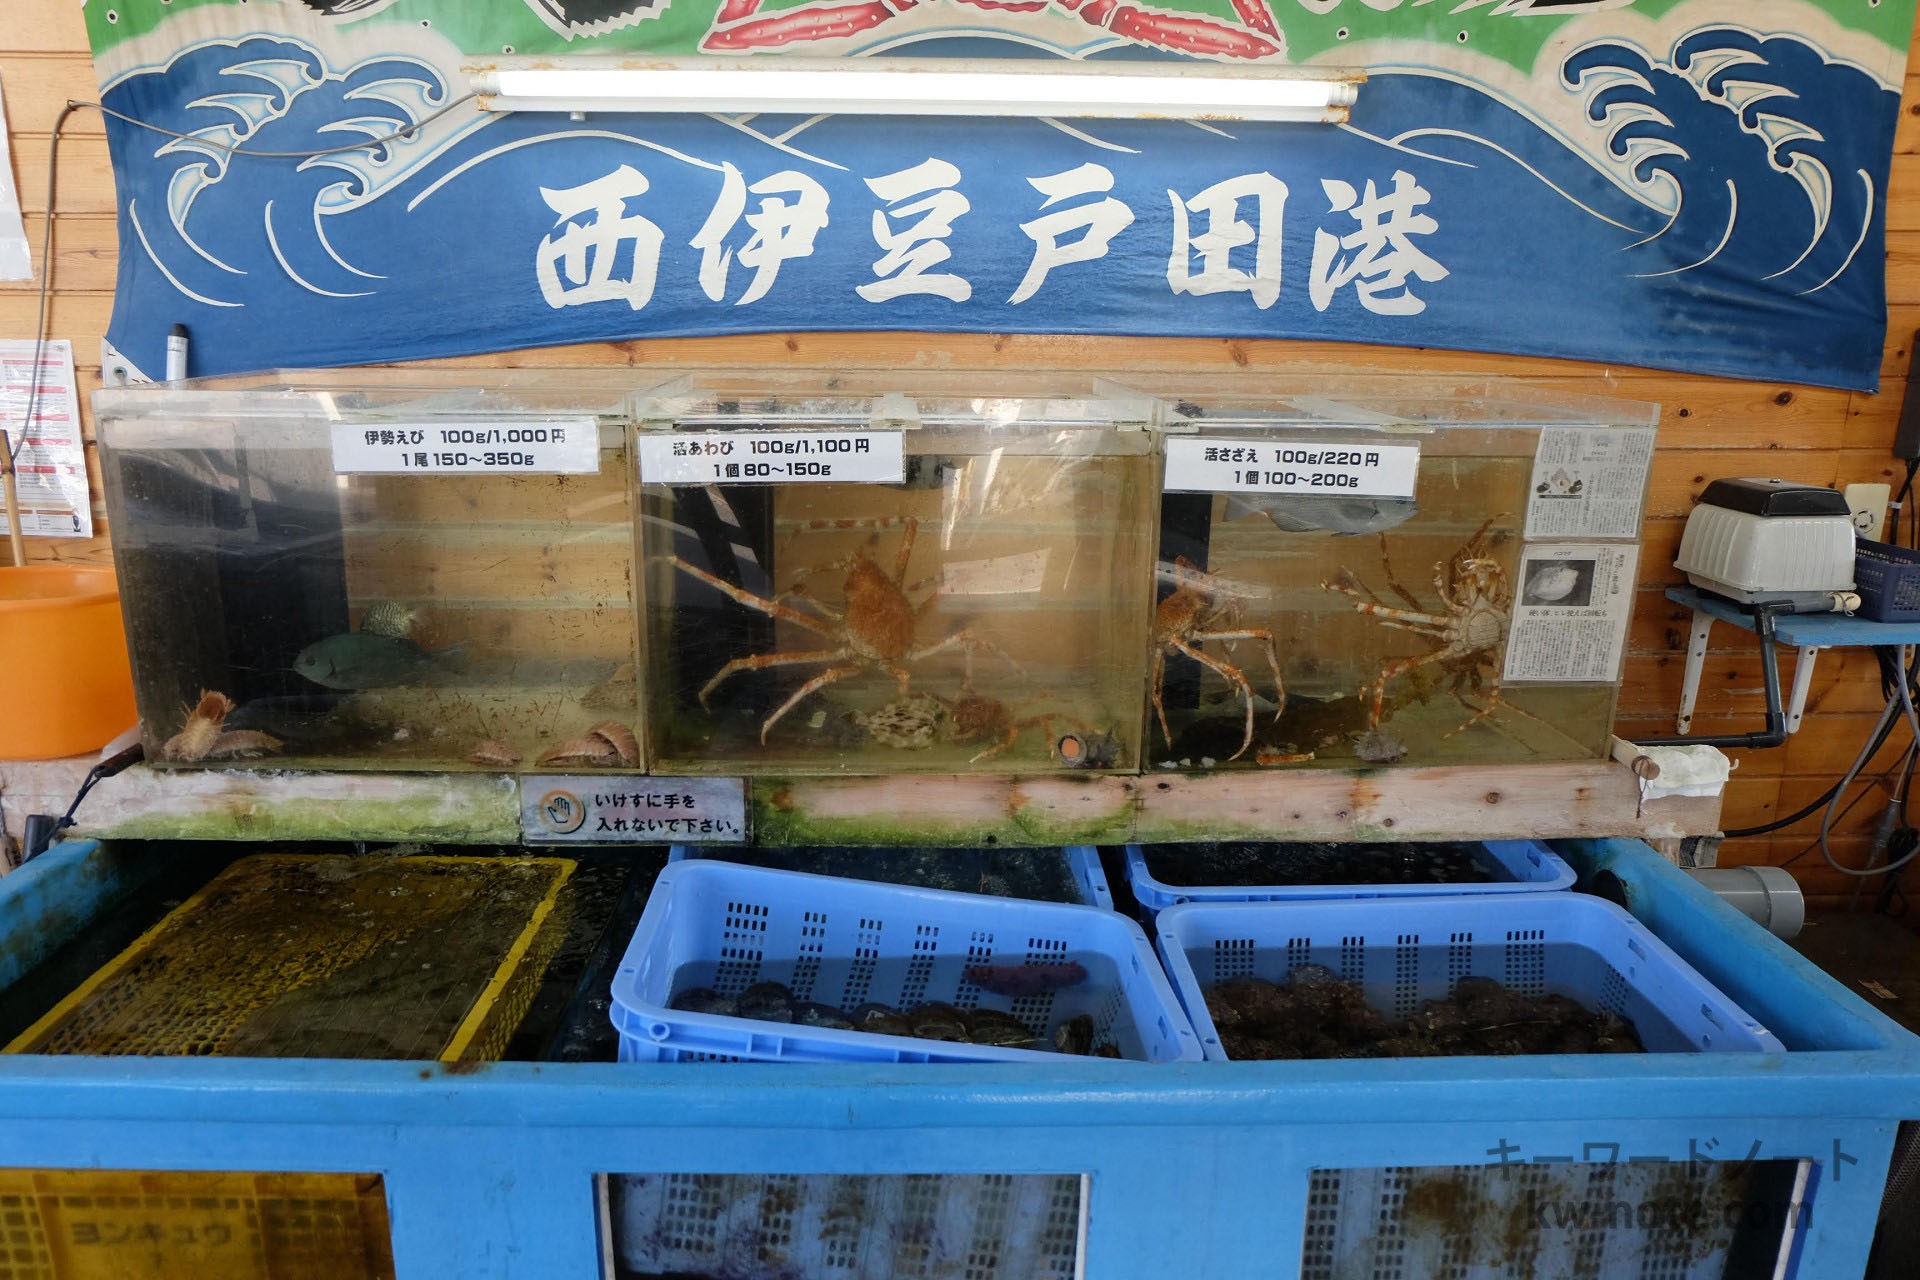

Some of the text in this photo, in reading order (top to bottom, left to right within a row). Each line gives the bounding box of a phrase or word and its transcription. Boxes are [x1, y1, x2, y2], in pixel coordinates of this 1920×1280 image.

[537, 159, 1451, 316] 西伊豆戸田港
[365, 430, 424, 445] 伊勢えび
[673, 440, 734, 456] 活あわび
[1204, 447, 1258, 463] 活さざえ
[595, 793, 695, 809] いけすに手を
[597, 817, 739, 834] 入れないで下さい。
